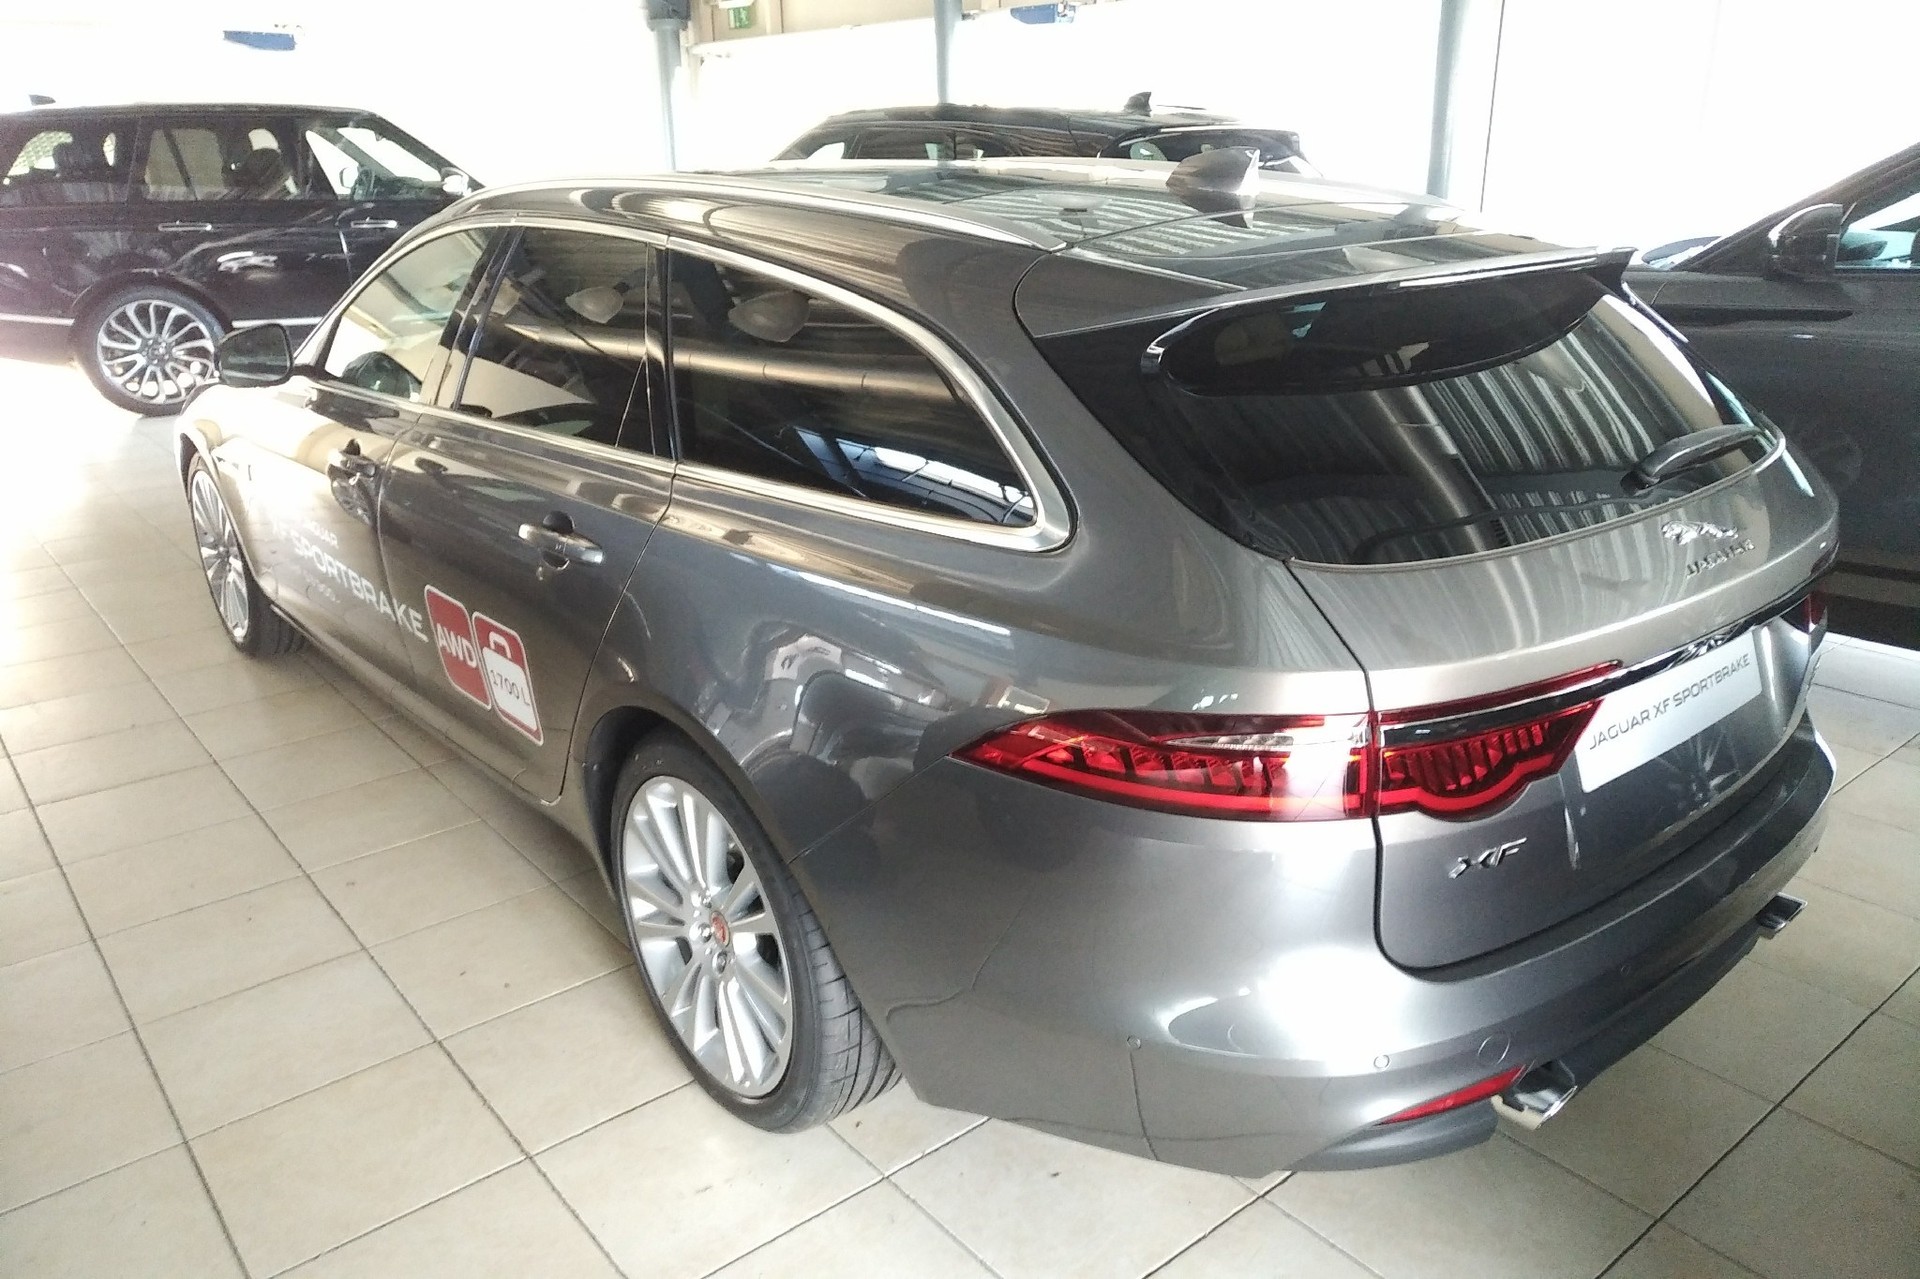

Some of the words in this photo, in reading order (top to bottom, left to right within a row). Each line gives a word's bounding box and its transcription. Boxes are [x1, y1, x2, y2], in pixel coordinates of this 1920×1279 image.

[290, 528, 430, 643] SPORTBRAKE
[436, 622, 478, 669] AWD
[1589, 709, 1651, 751] JAGUAR
[1653, 697, 1671, 719] XF
[1672, 653, 1750, 708] SPORTBRAKE
[1448, 837, 1528, 879] XF
